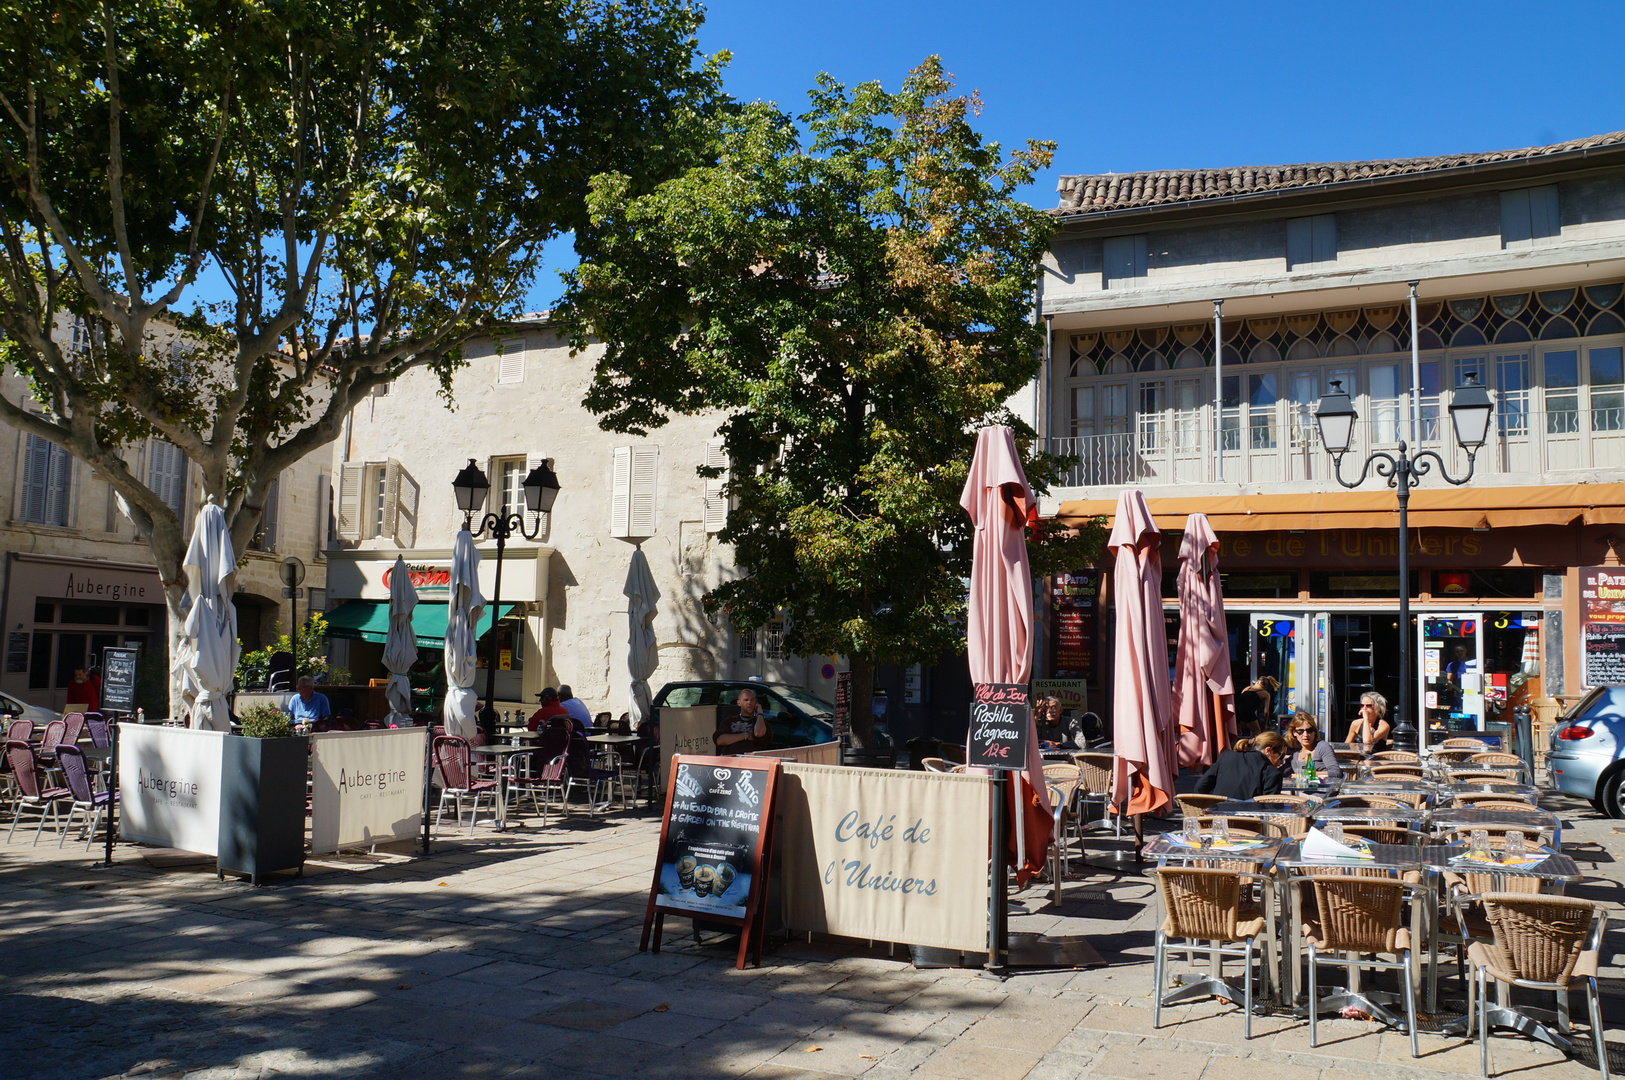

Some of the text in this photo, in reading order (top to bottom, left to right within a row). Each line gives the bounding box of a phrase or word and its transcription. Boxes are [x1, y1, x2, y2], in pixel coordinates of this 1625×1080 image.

[1265, 531, 1306, 557] de
[65, 572, 146, 600] Aubergine
[1259, 619, 1274, 637] 3
[993, 688, 1006, 701] du
[974, 703, 1015, 723] Pastilla
[674, 734, 709, 752] Aubergine
[974, 722, 1019, 747] d'agneau
[982, 743, 1011, 758] 12€
[138, 767, 198, 798] Aubergine
[338, 767, 406, 797] Aubergine
[379, 788, 405, 798] RESTAURANT
[170, 800, 198, 809] RESTAURANT
[835, 810, 931, 849] Café de
[824, 858, 938, 897] l'Univers
